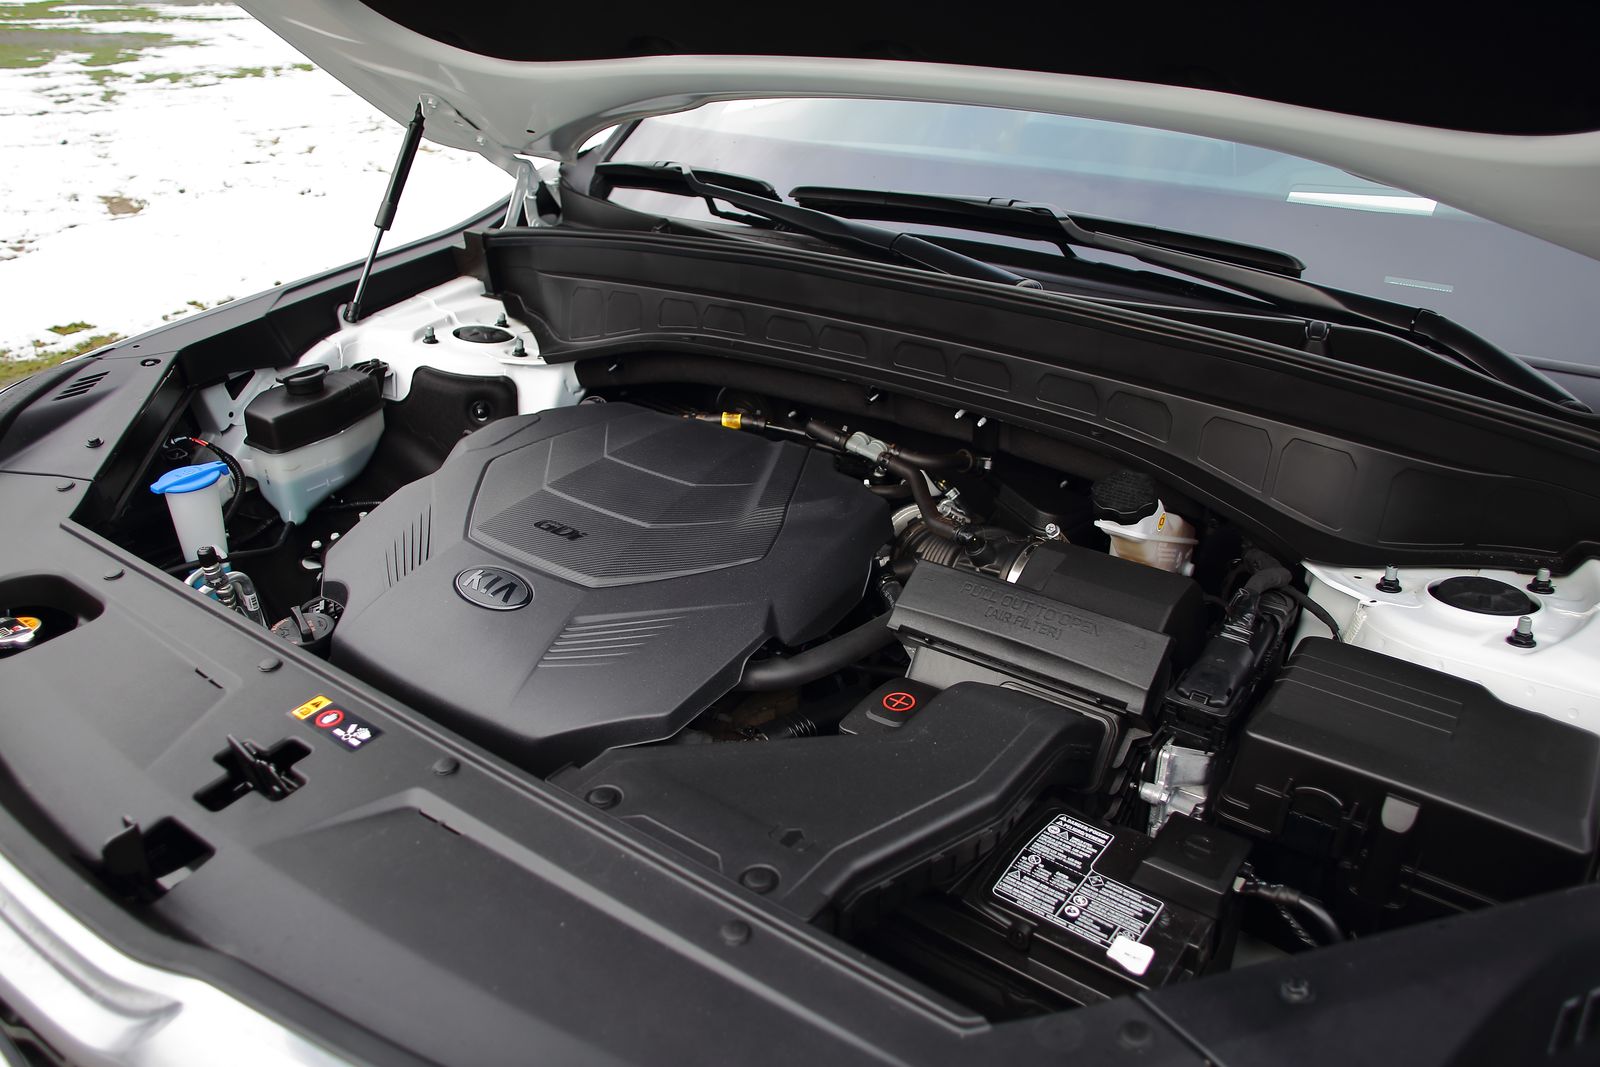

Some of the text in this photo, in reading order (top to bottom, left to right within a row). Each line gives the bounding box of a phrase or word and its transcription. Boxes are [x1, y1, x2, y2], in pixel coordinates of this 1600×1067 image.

[463, 569, 518, 604] KIA
[961, 581, 997, 604] PULL
[1002, 593, 1036, 615] OUT
[1037, 603, 1058, 621] TO
